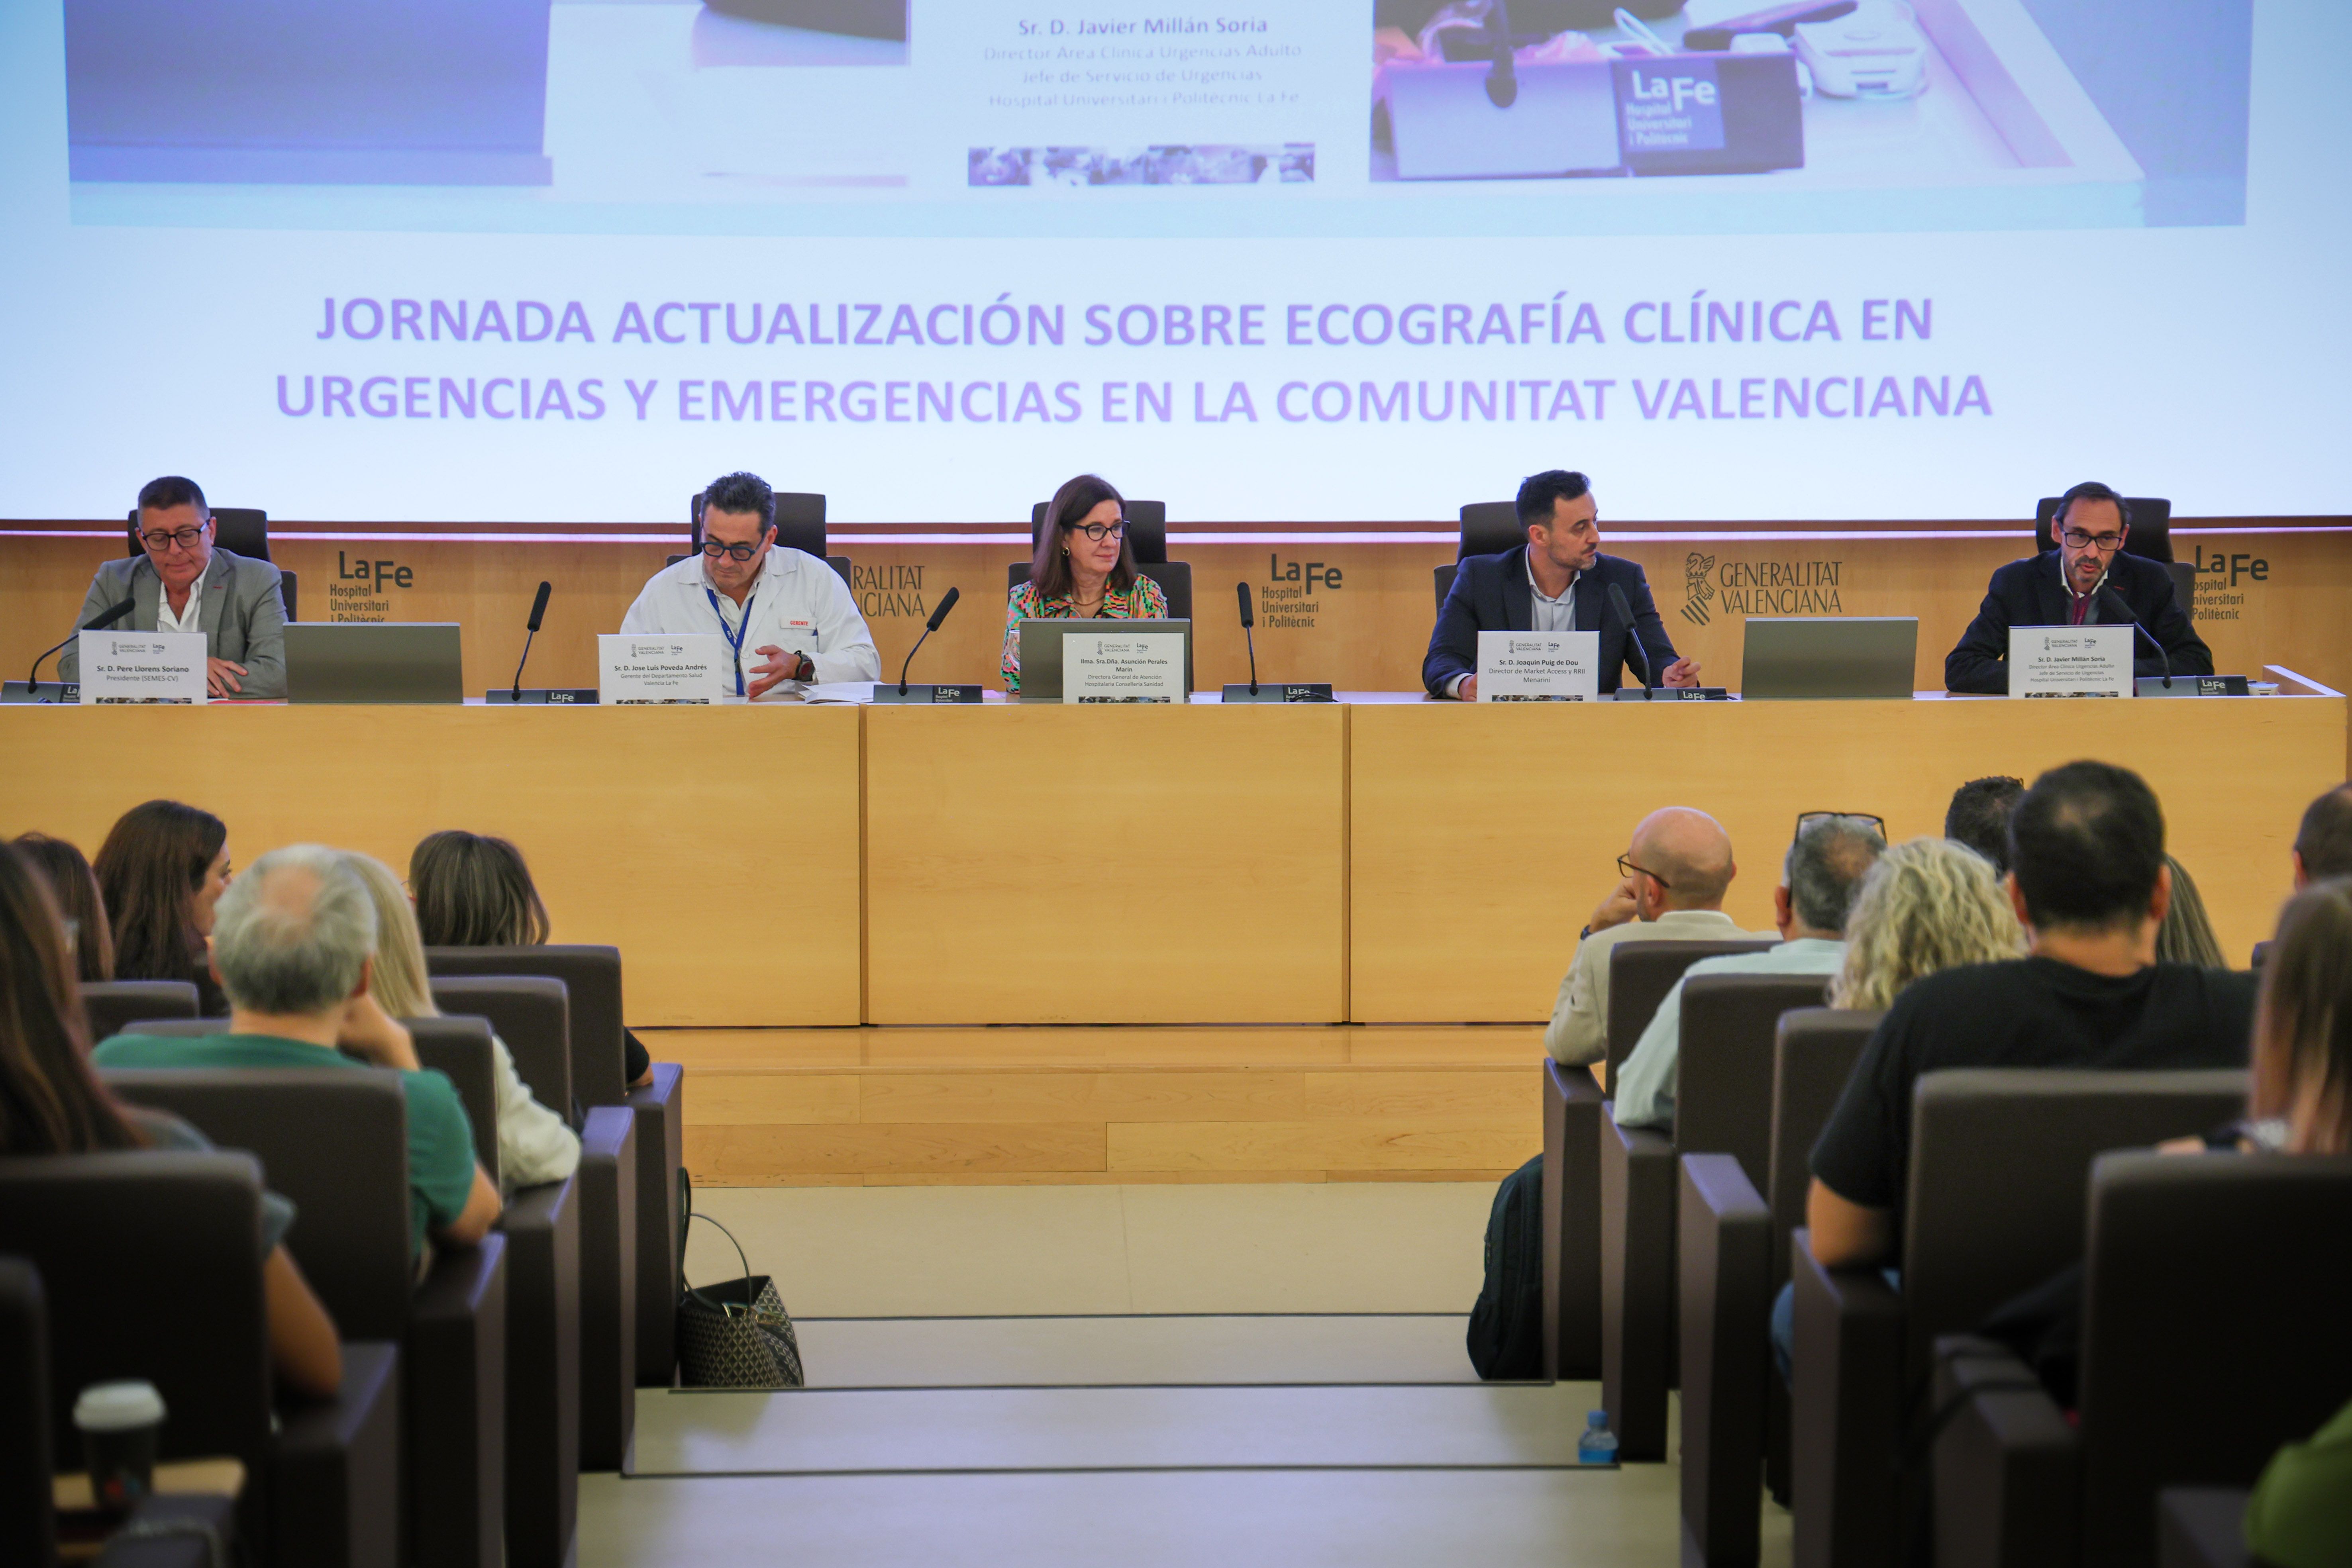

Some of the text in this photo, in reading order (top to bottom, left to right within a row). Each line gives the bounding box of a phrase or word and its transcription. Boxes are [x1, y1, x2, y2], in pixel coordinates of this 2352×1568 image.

[1018, 17, 1268, 36] Sr. D. Javier Millán Soria
[983, 47, 1051, 61] Director
[1246, 43, 1302, 57] Adulto
[1059, 70, 1081, 83] de
[1085, 71, 1151, 83] Servicio
[1155, 69, 1176, 82] de
[988, 93, 1058, 110] Hospital
[316, 288, 1932, 346] JORNADA ACTUALIZACIÓN SOBRE ECOGRAFÍA CLÍNICA EN
[276, 374, 1993, 423] URGENCIAS Y EMERGENCIAS EN LA COMUNITAT VALENCIANA
[853, 565, 925, 590] RALITAT
[1720, 561, 1842, 587] GENERALITAT
[330, 584, 371, 599] Hospital
[1262, 586, 1302, 602] Hospital
[2194, 578, 2226, 594] ospital
[330, 599, 389, 612] Universitari
[1262, 601, 1319, 614] Universitari
[1720, 589, 1842, 614] VALENCIANA
[2193, 593, 2244, 606] niversitari
[1262, 615, 1315, 628] i Politècnic
